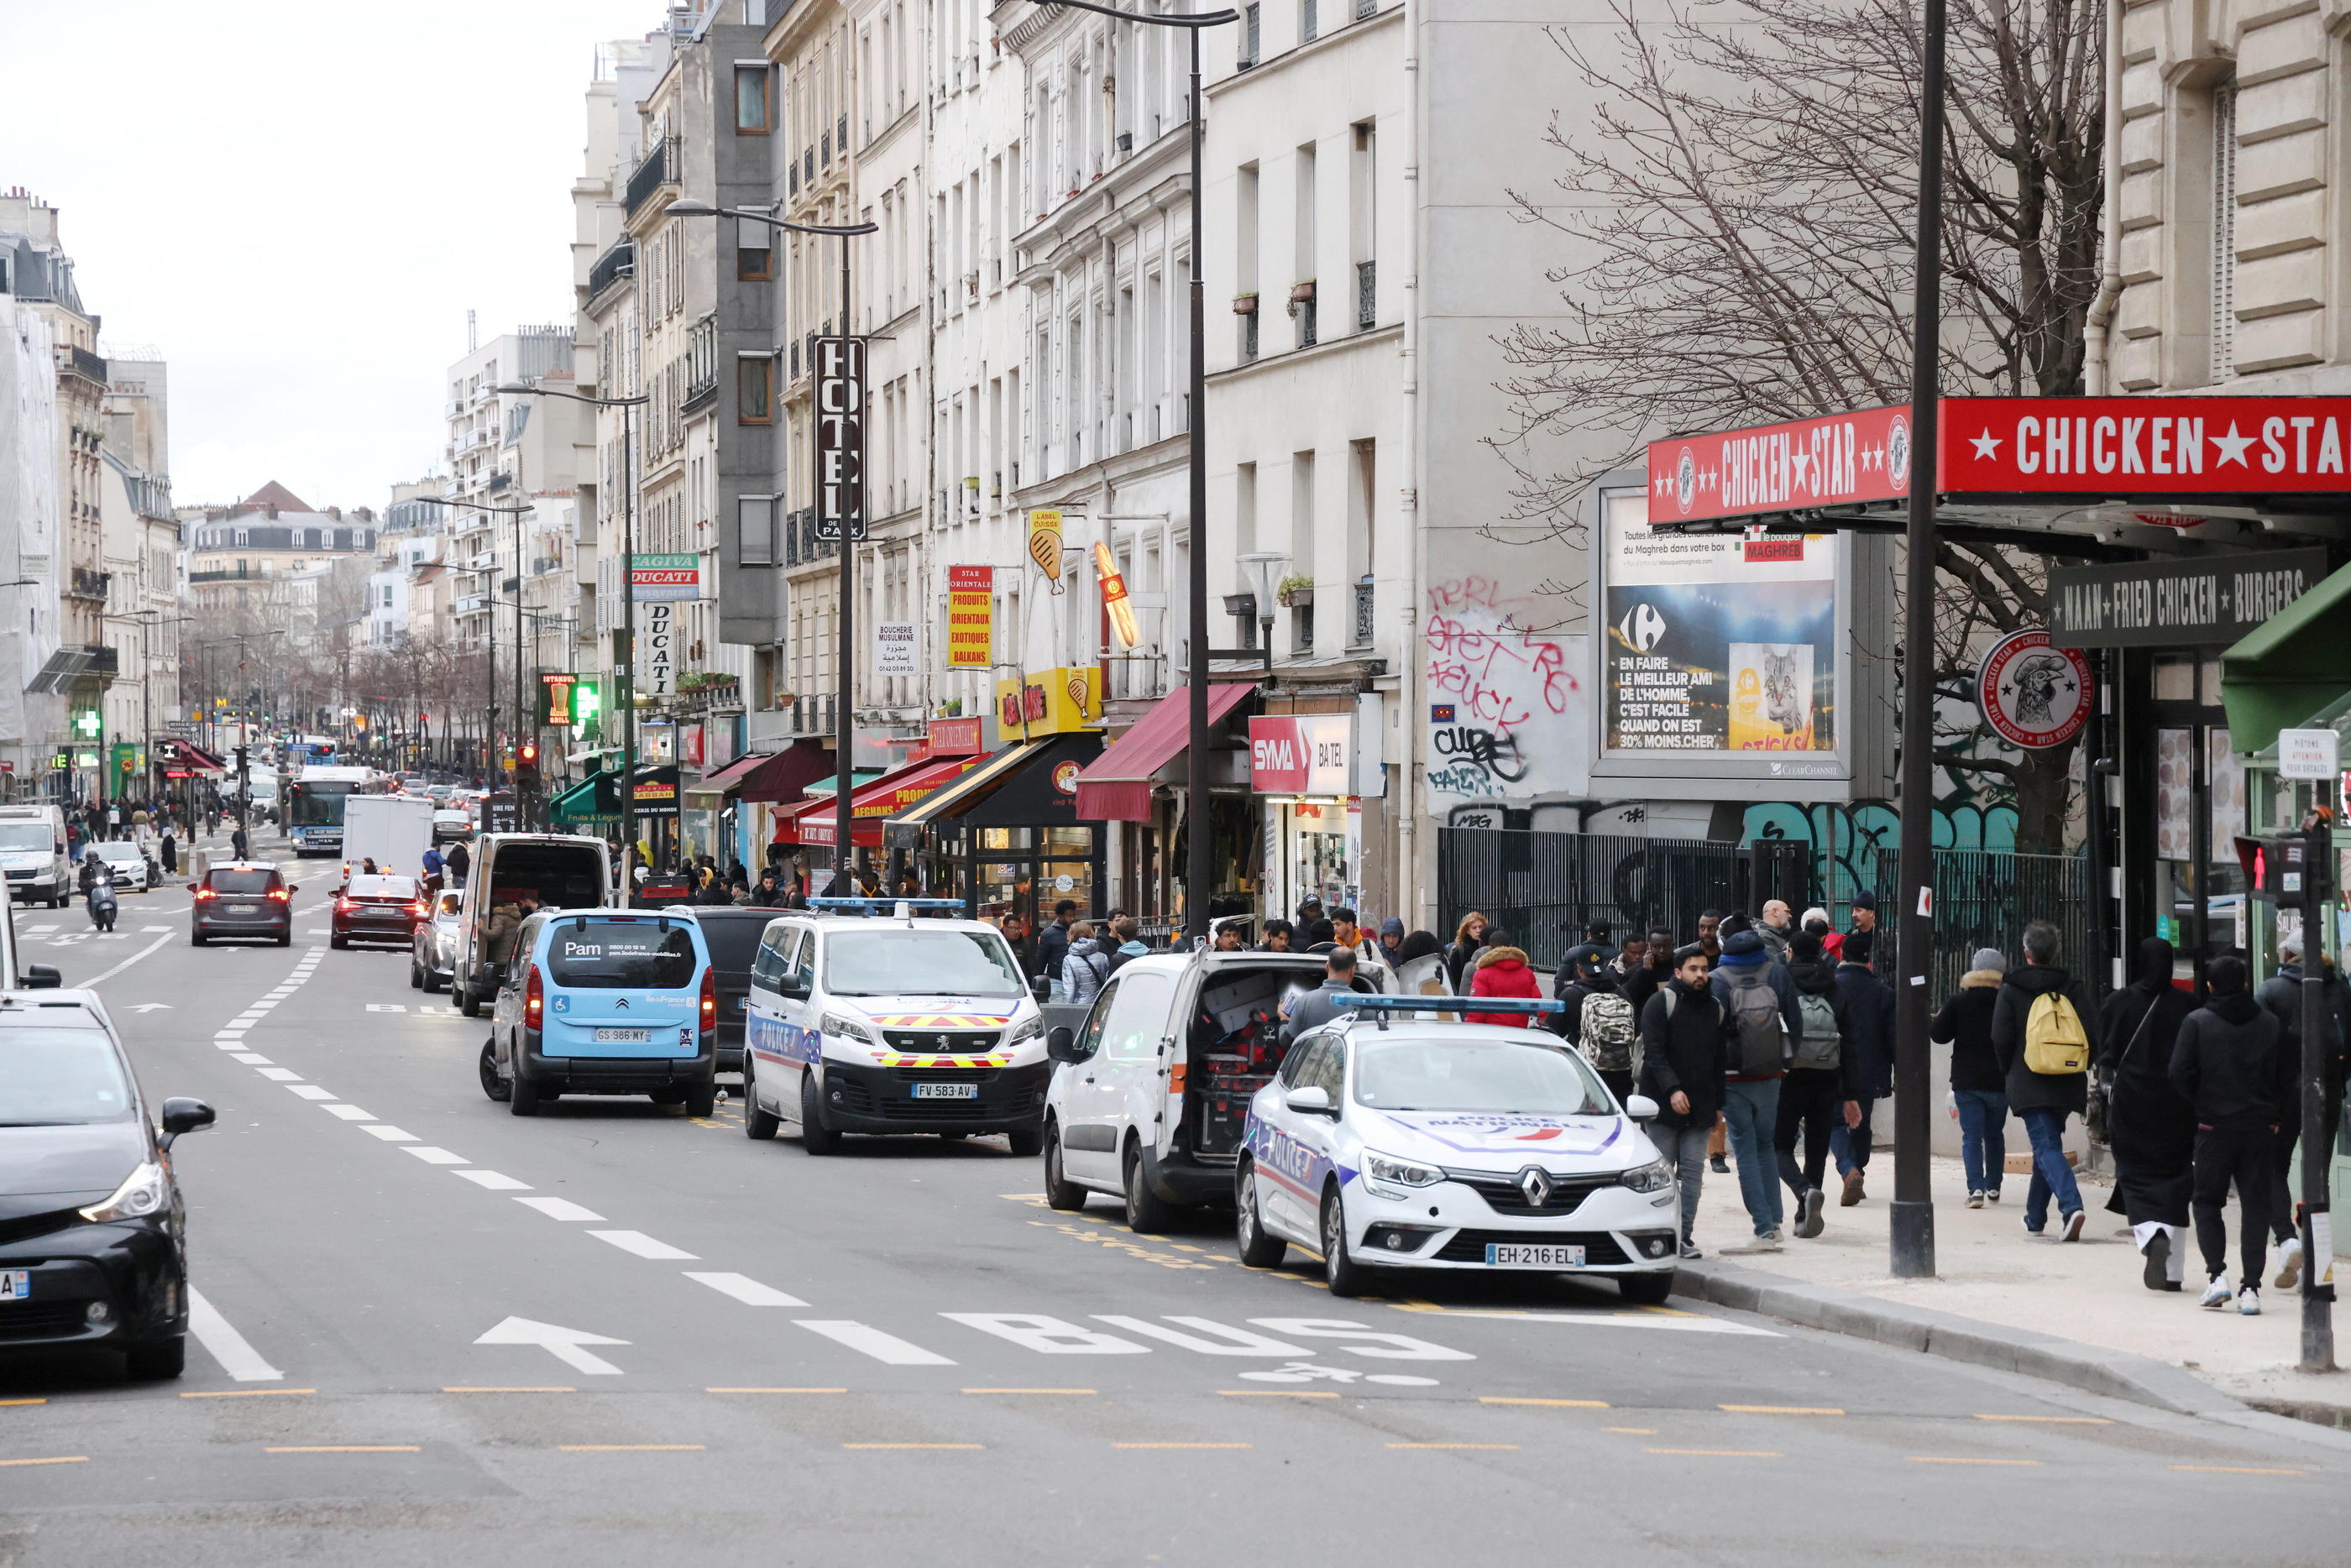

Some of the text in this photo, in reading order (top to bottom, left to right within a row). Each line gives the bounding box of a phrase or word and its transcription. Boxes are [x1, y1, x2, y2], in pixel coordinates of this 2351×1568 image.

[821, 342, 859, 519] HOTEL
[2017, 416, 2351, 474] CHICKEN STA
[1721, 431, 1790, 508] CHICKEN
[1810, 422, 1856, 497] STAR
[823, 527, 859, 536] PAX
[1625, 531, 1646, 541] Toutes
[1647, 531, 1657, 540] les
[1623, 542, 1725, 556] du Maghreb dans votre box
[1747, 542, 1801, 559] MAGHREB
[631, 557, 694, 567] CAGIVA
[631, 572, 694, 583] DUCATI
[953, 594, 988, 605] PRODUITS
[2065, 569, 2304, 631] NAAN FRIED CHICKEN BURGERS
[951, 614, 989, 625] ORIENTAUX
[880, 625, 913, 634] BOUCHERIE
[878, 634, 914, 642] MUSULMANE
[951, 632, 989, 644] EXOTIQUES
[651, 606, 670, 693] DUCATI
[954, 651, 986, 662] BALKANS
[1620, 656, 1668, 670] EN FAIRE
[1620, 672, 1713, 685] LE MEILLEUR AMI
[1620, 688, 1690, 703] DE L'HOMME,
[1620, 703, 1689, 717] C'EST FACILE
[1620, 719, 1702, 734] QUAND ON EST
[1620, 734, 1642, 748] 30%
[1644, 734, 1681, 748] MOINS
[1254, 739, 1295, 771] SYMA
[1318, 743, 1343, 767] BA TEL
[1347, 798, 1361, 809] SYMA
[568, 813, 588, 822] Fruits
[854, 805, 893, 817] AFGHANS
[565, 941, 601, 956] Pam
[762, 1022, 789, 1053] POLICE
[1427, 1119, 1596, 1130] NATIONALE
[1455, 1115, 1558, 1124] POLICE
[1268, 1130, 1302, 1179] POLICE
[936, 1312, 1478, 1362] BUS
